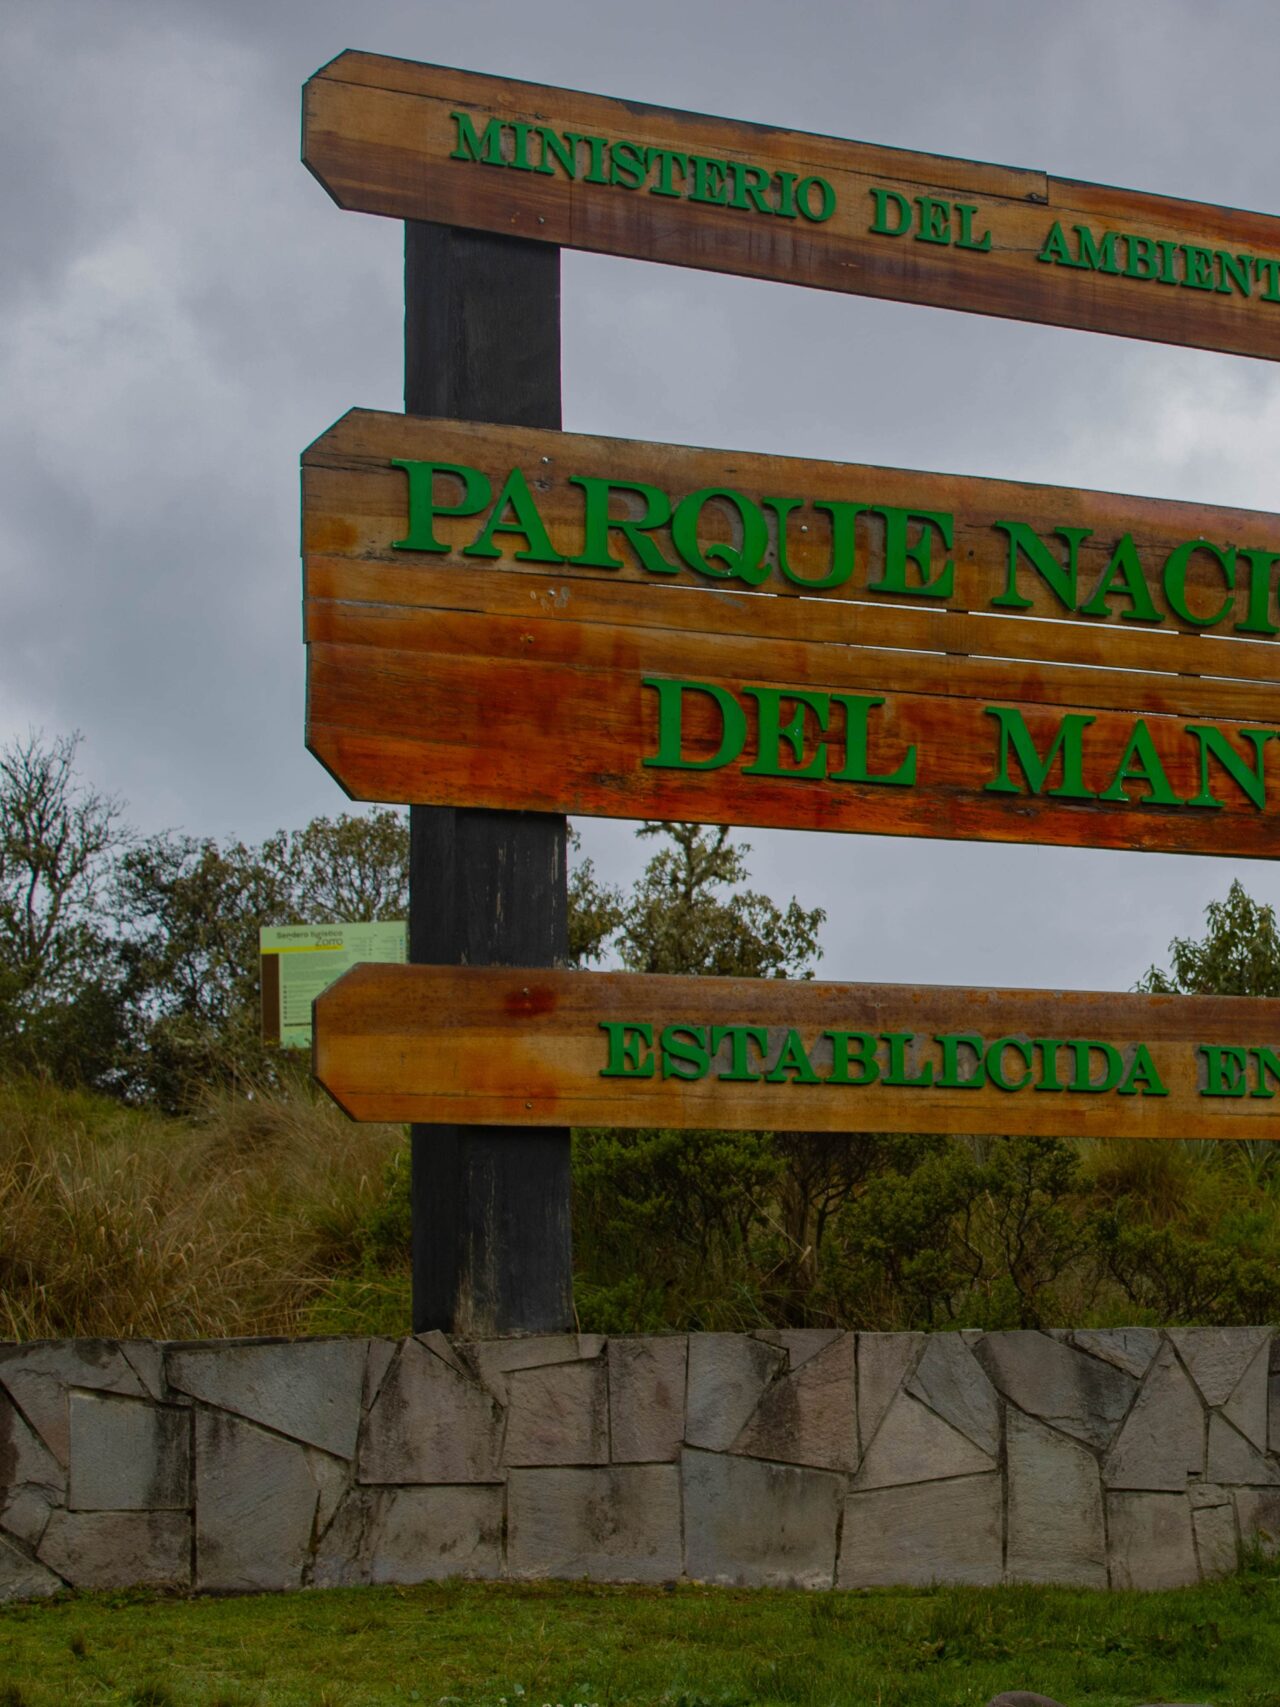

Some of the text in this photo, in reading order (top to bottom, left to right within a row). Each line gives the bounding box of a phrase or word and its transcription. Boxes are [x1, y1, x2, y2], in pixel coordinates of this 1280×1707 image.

[450, 112, 837, 222] MINISTERIO
[870, 188, 992, 252] DEL
[390, 457, 955, 599] PARQUE
[642, 676, 917, 787] DEL
[599, 1020, 1170, 1096] ESTABLECIDA
